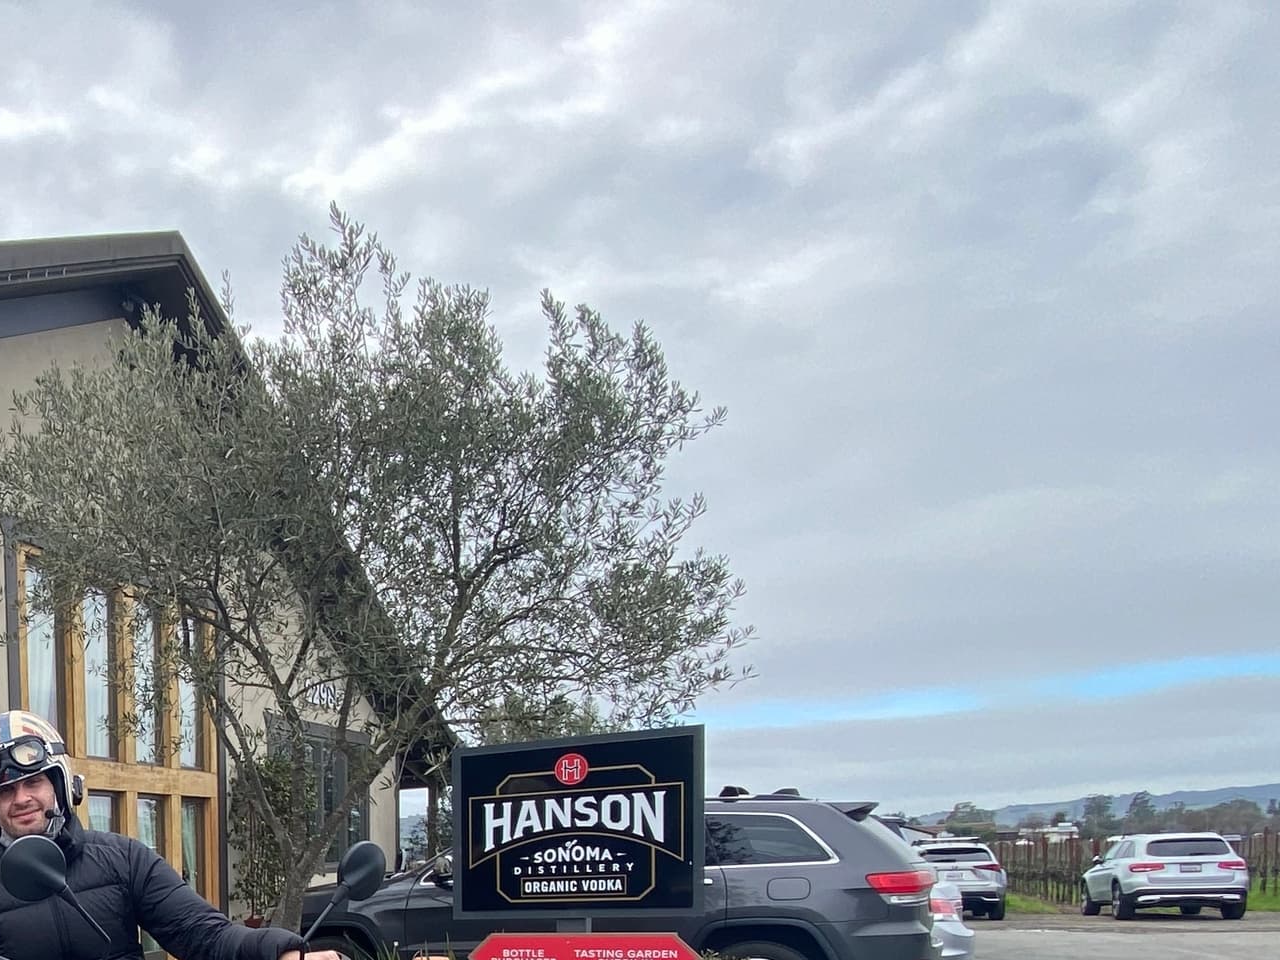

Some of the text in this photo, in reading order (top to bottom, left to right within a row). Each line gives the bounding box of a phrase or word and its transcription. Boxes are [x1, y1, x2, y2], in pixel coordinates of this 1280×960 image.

[483, 790, 667, 852] HANSON
[534, 845, 613, 863] SONOMA
[513, 863, 635, 876] DISTILLERY
[524, 878, 624, 893] ORGANIC VODKA
[502, 949, 545, 958] BOTTLE
[574, 949, 678, 959] TASTING GARDEN
